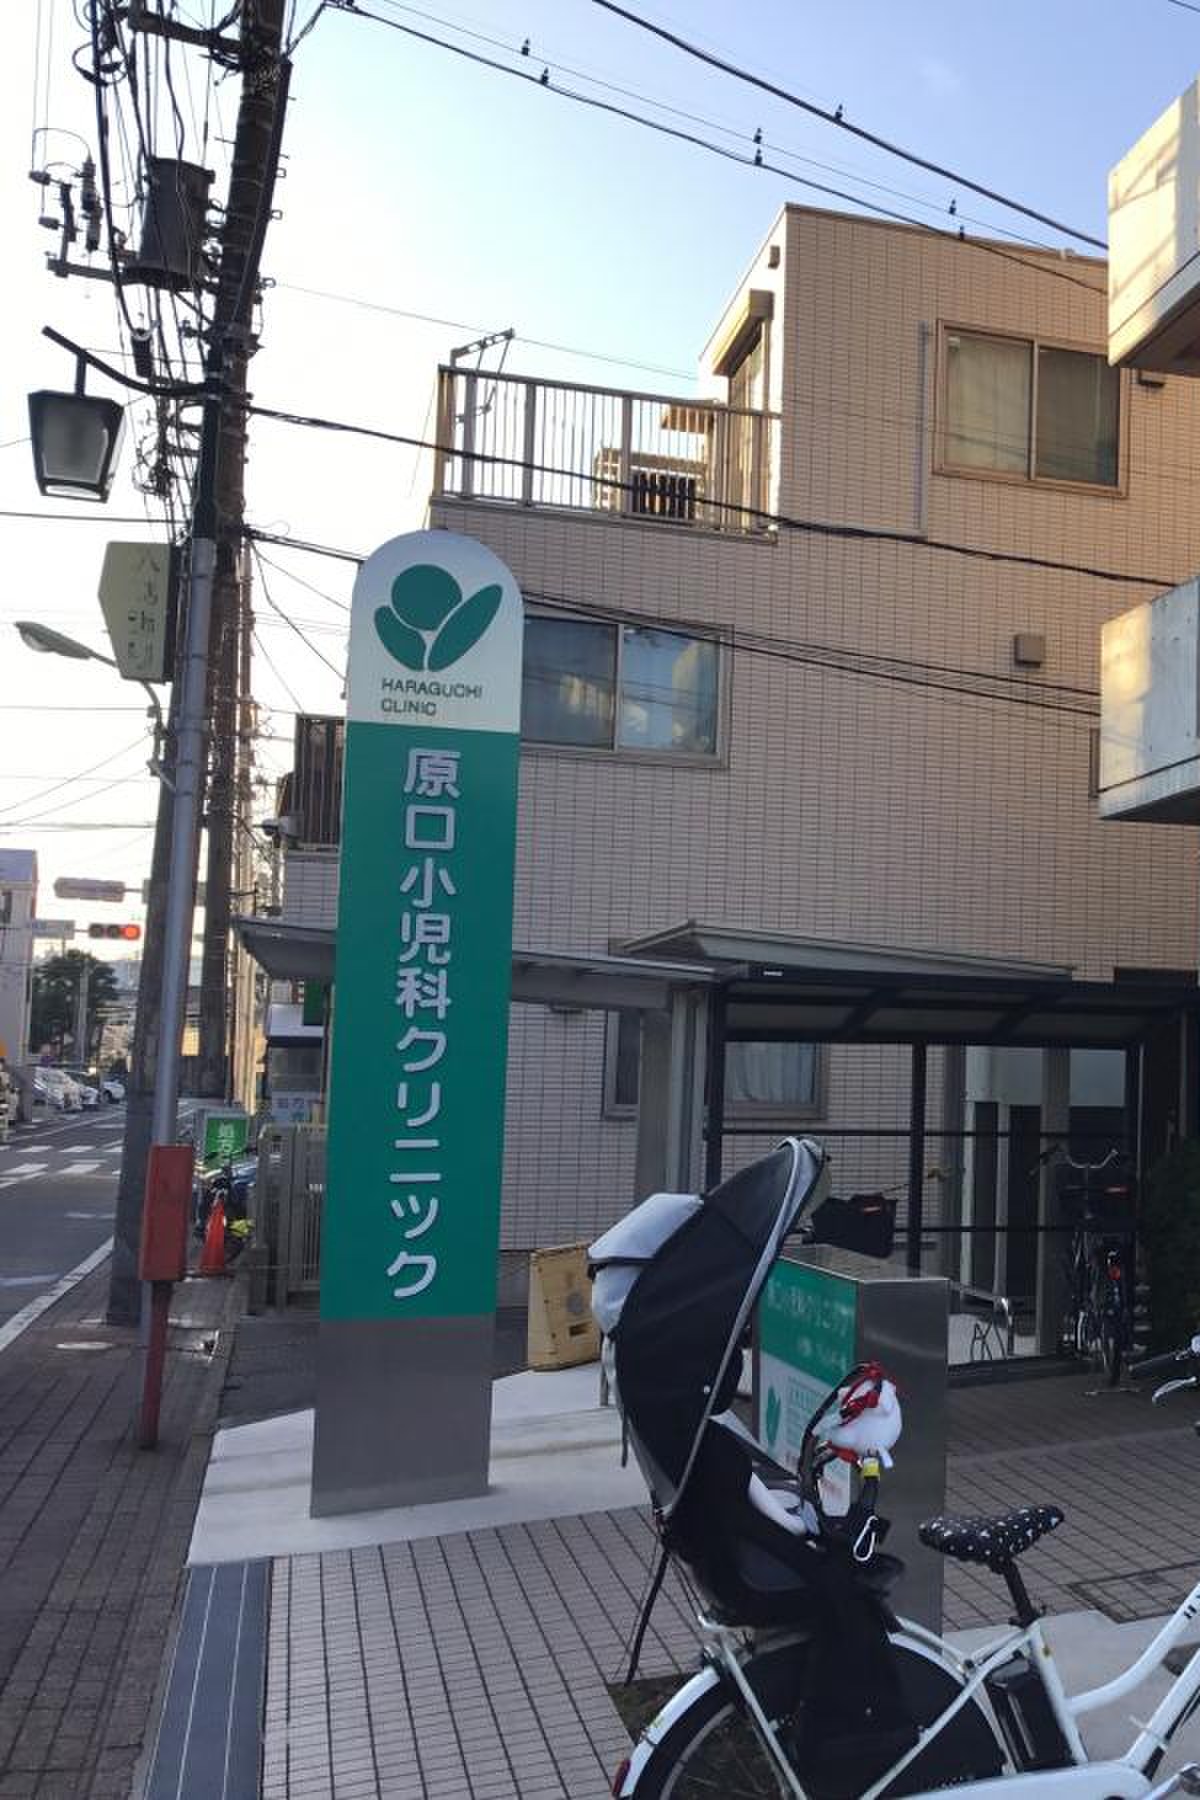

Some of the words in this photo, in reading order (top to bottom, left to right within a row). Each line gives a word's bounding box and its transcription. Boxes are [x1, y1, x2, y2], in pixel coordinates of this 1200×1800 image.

[381, 678, 483, 699] HARAGUCHI
[380, 698, 437, 717] CLINIC
[387, 748, 461, 1298] 原口小児科クリニック
